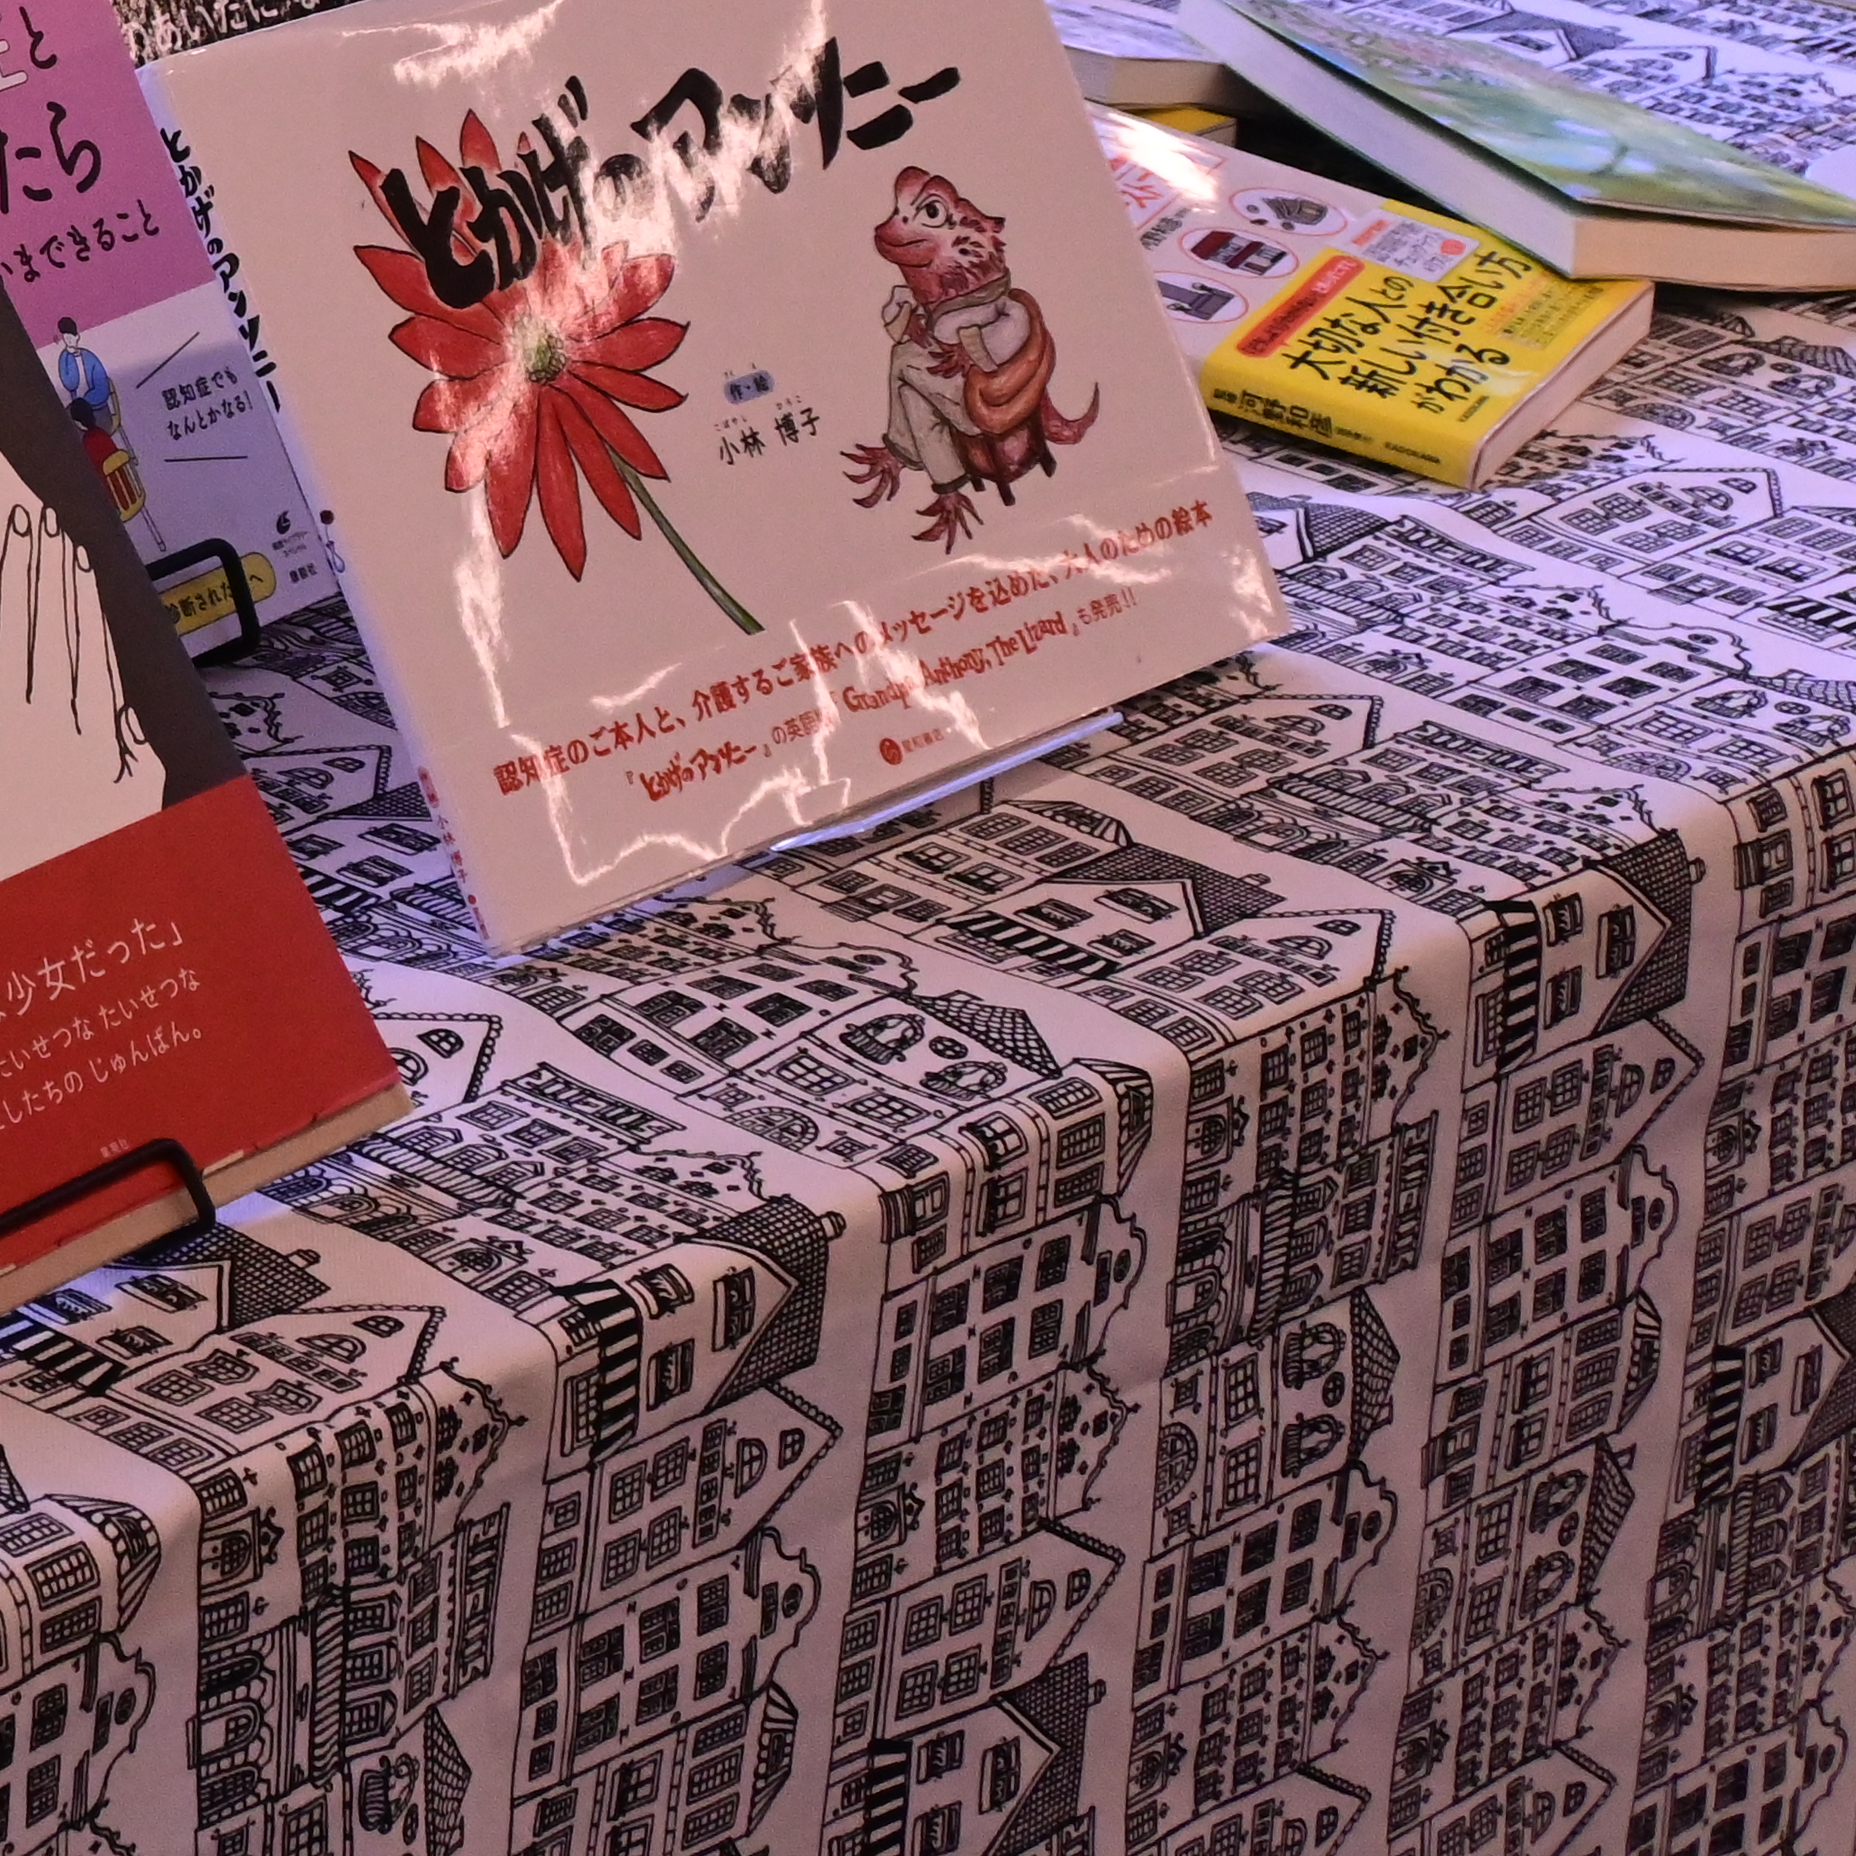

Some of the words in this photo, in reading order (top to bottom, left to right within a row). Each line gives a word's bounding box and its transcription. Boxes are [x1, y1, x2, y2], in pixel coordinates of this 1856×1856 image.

[160, 127, 280, 413] とかげのアンソニー
[1282, 276, 1414, 381] 大切な人との
[1338, 251, 1533, 400] 新しい付き合い方
[162, 366, 238, 411] 認知症でも
[1412, 343, 1510, 414] がわかる
[167, 390, 254, 441] なんとかなる!
[719, 426, 766, 465] 小林
[774, 407, 820, 446] 博子
[97, 966, 202, 1031] たいせつな
[88, 1024, 203, 1085] じゅんばん。
